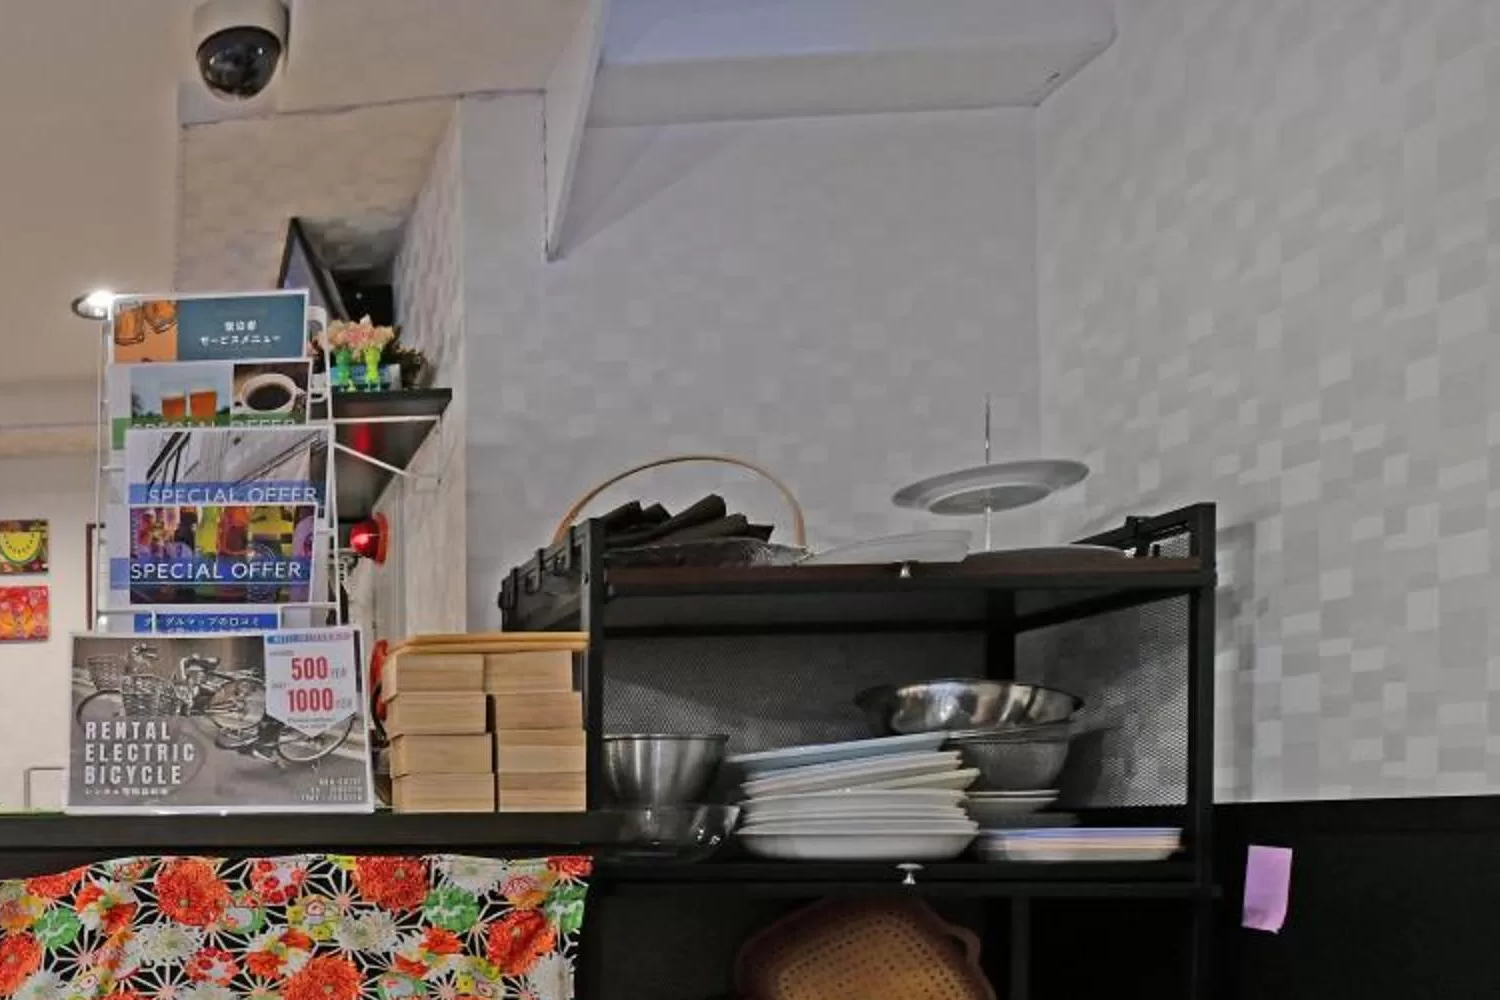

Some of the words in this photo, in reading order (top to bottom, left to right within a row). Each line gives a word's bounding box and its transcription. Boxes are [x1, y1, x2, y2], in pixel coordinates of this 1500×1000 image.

[149, 488, 236, 503] SPECIAL
[248, 487, 318, 502] OFFER
[131, 563, 224, 579] SPECIAL
[231, 561, 301, 579] OFFER
[291, 656, 329, 680] 500
[287, 687, 334, 712] 1000
[85, 721, 171, 740] RENTAL
[85, 743, 195, 762] ELECTRIC
[84, 765, 181, 785] BICYCLE
